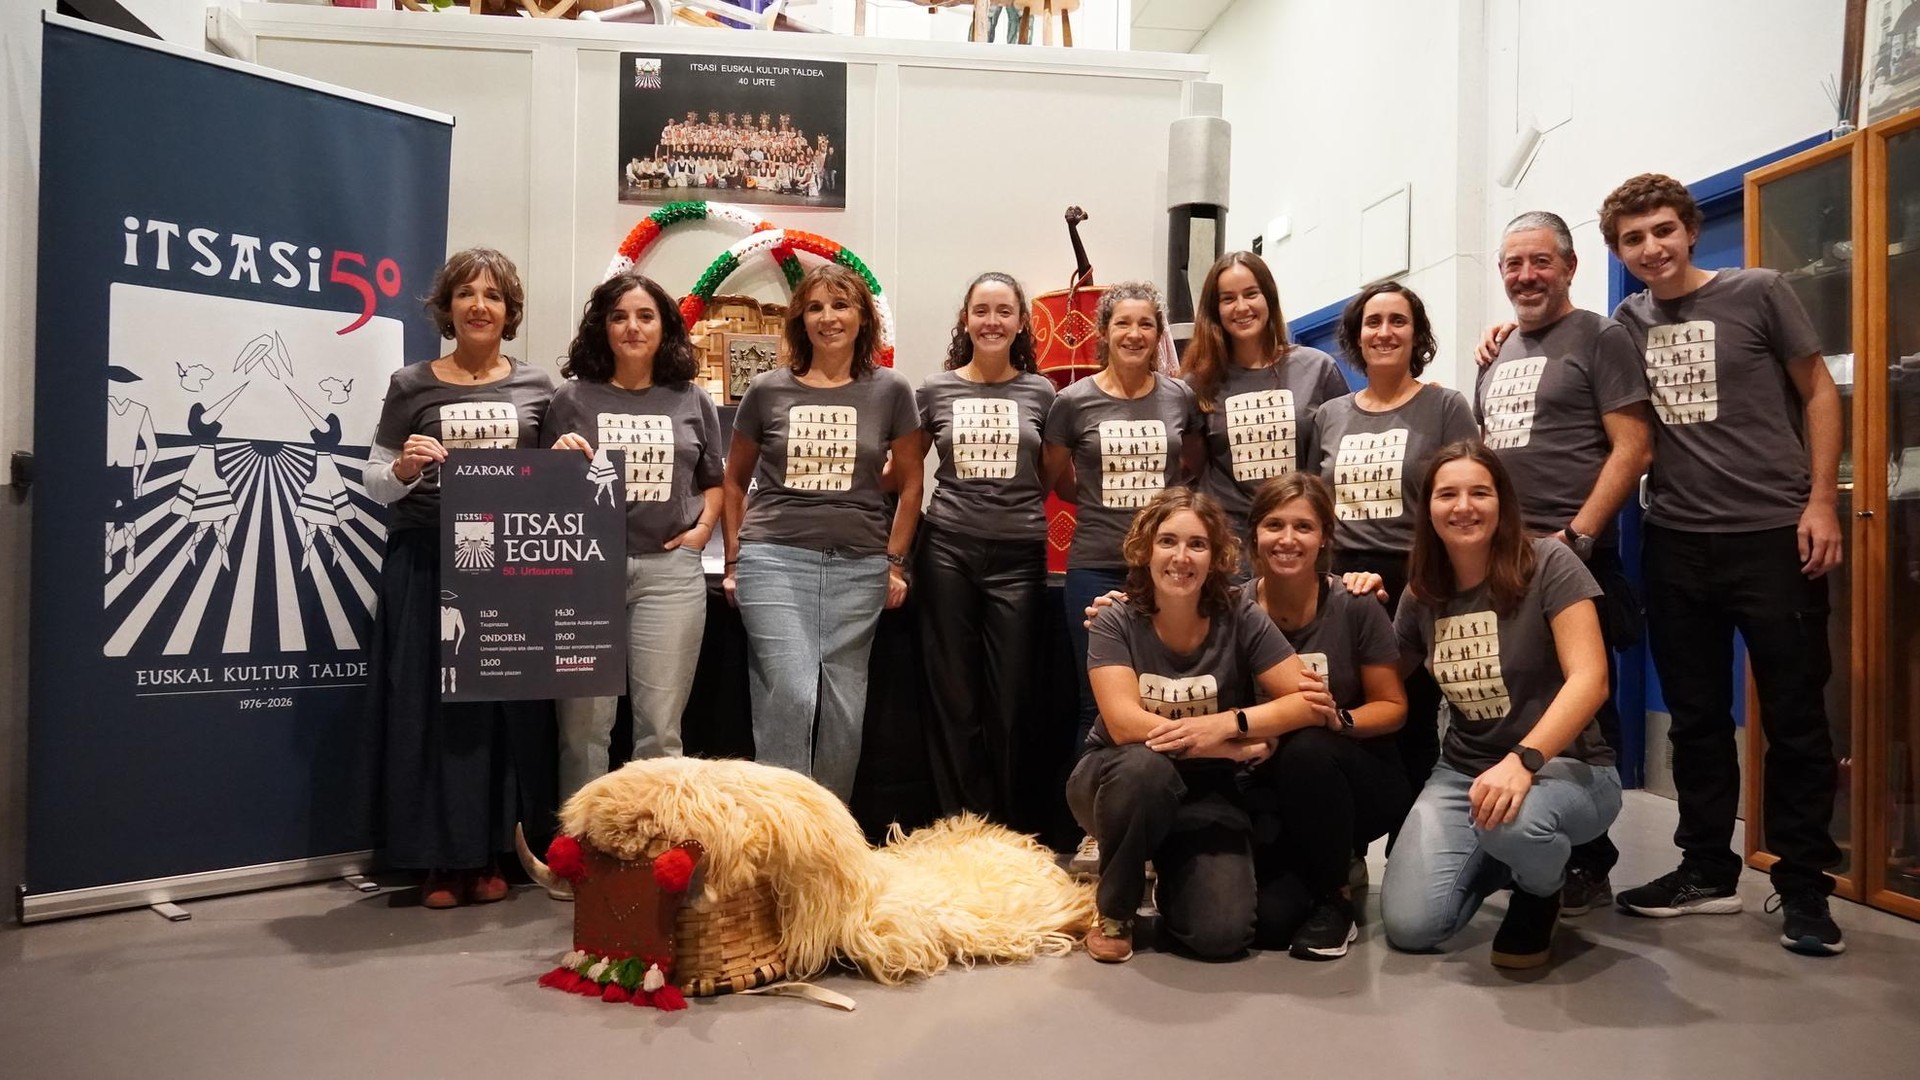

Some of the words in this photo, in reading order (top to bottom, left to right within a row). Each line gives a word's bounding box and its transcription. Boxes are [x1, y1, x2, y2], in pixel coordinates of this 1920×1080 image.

[690, 63, 717, 72] ITSASI
[721, 64, 754, 73] EUSKAL
[756, 65, 790, 75] KULTUR
[791, 67, 824, 77] TALDEA
[738, 77, 749, 86] 40
[753, 78, 776, 87] URTE
[455, 465, 515, 476] AZAROAK
[520, 466, 532, 476] 14
[502, 512, 585, 536] ITSASI
[503, 539, 605, 562] EGUNA
[480, 609, 498, 618] 11:30
[555, 608, 575, 617] 14:30
[480, 633, 526, 642] ONDOREN
[555, 632, 575, 641] 19:00
[480, 658, 501, 667] 13:00
[135, 667, 214, 686] EUSKAL
[223, 664, 300, 682] KULTUR
[309, 662, 368, 678] TALDE
